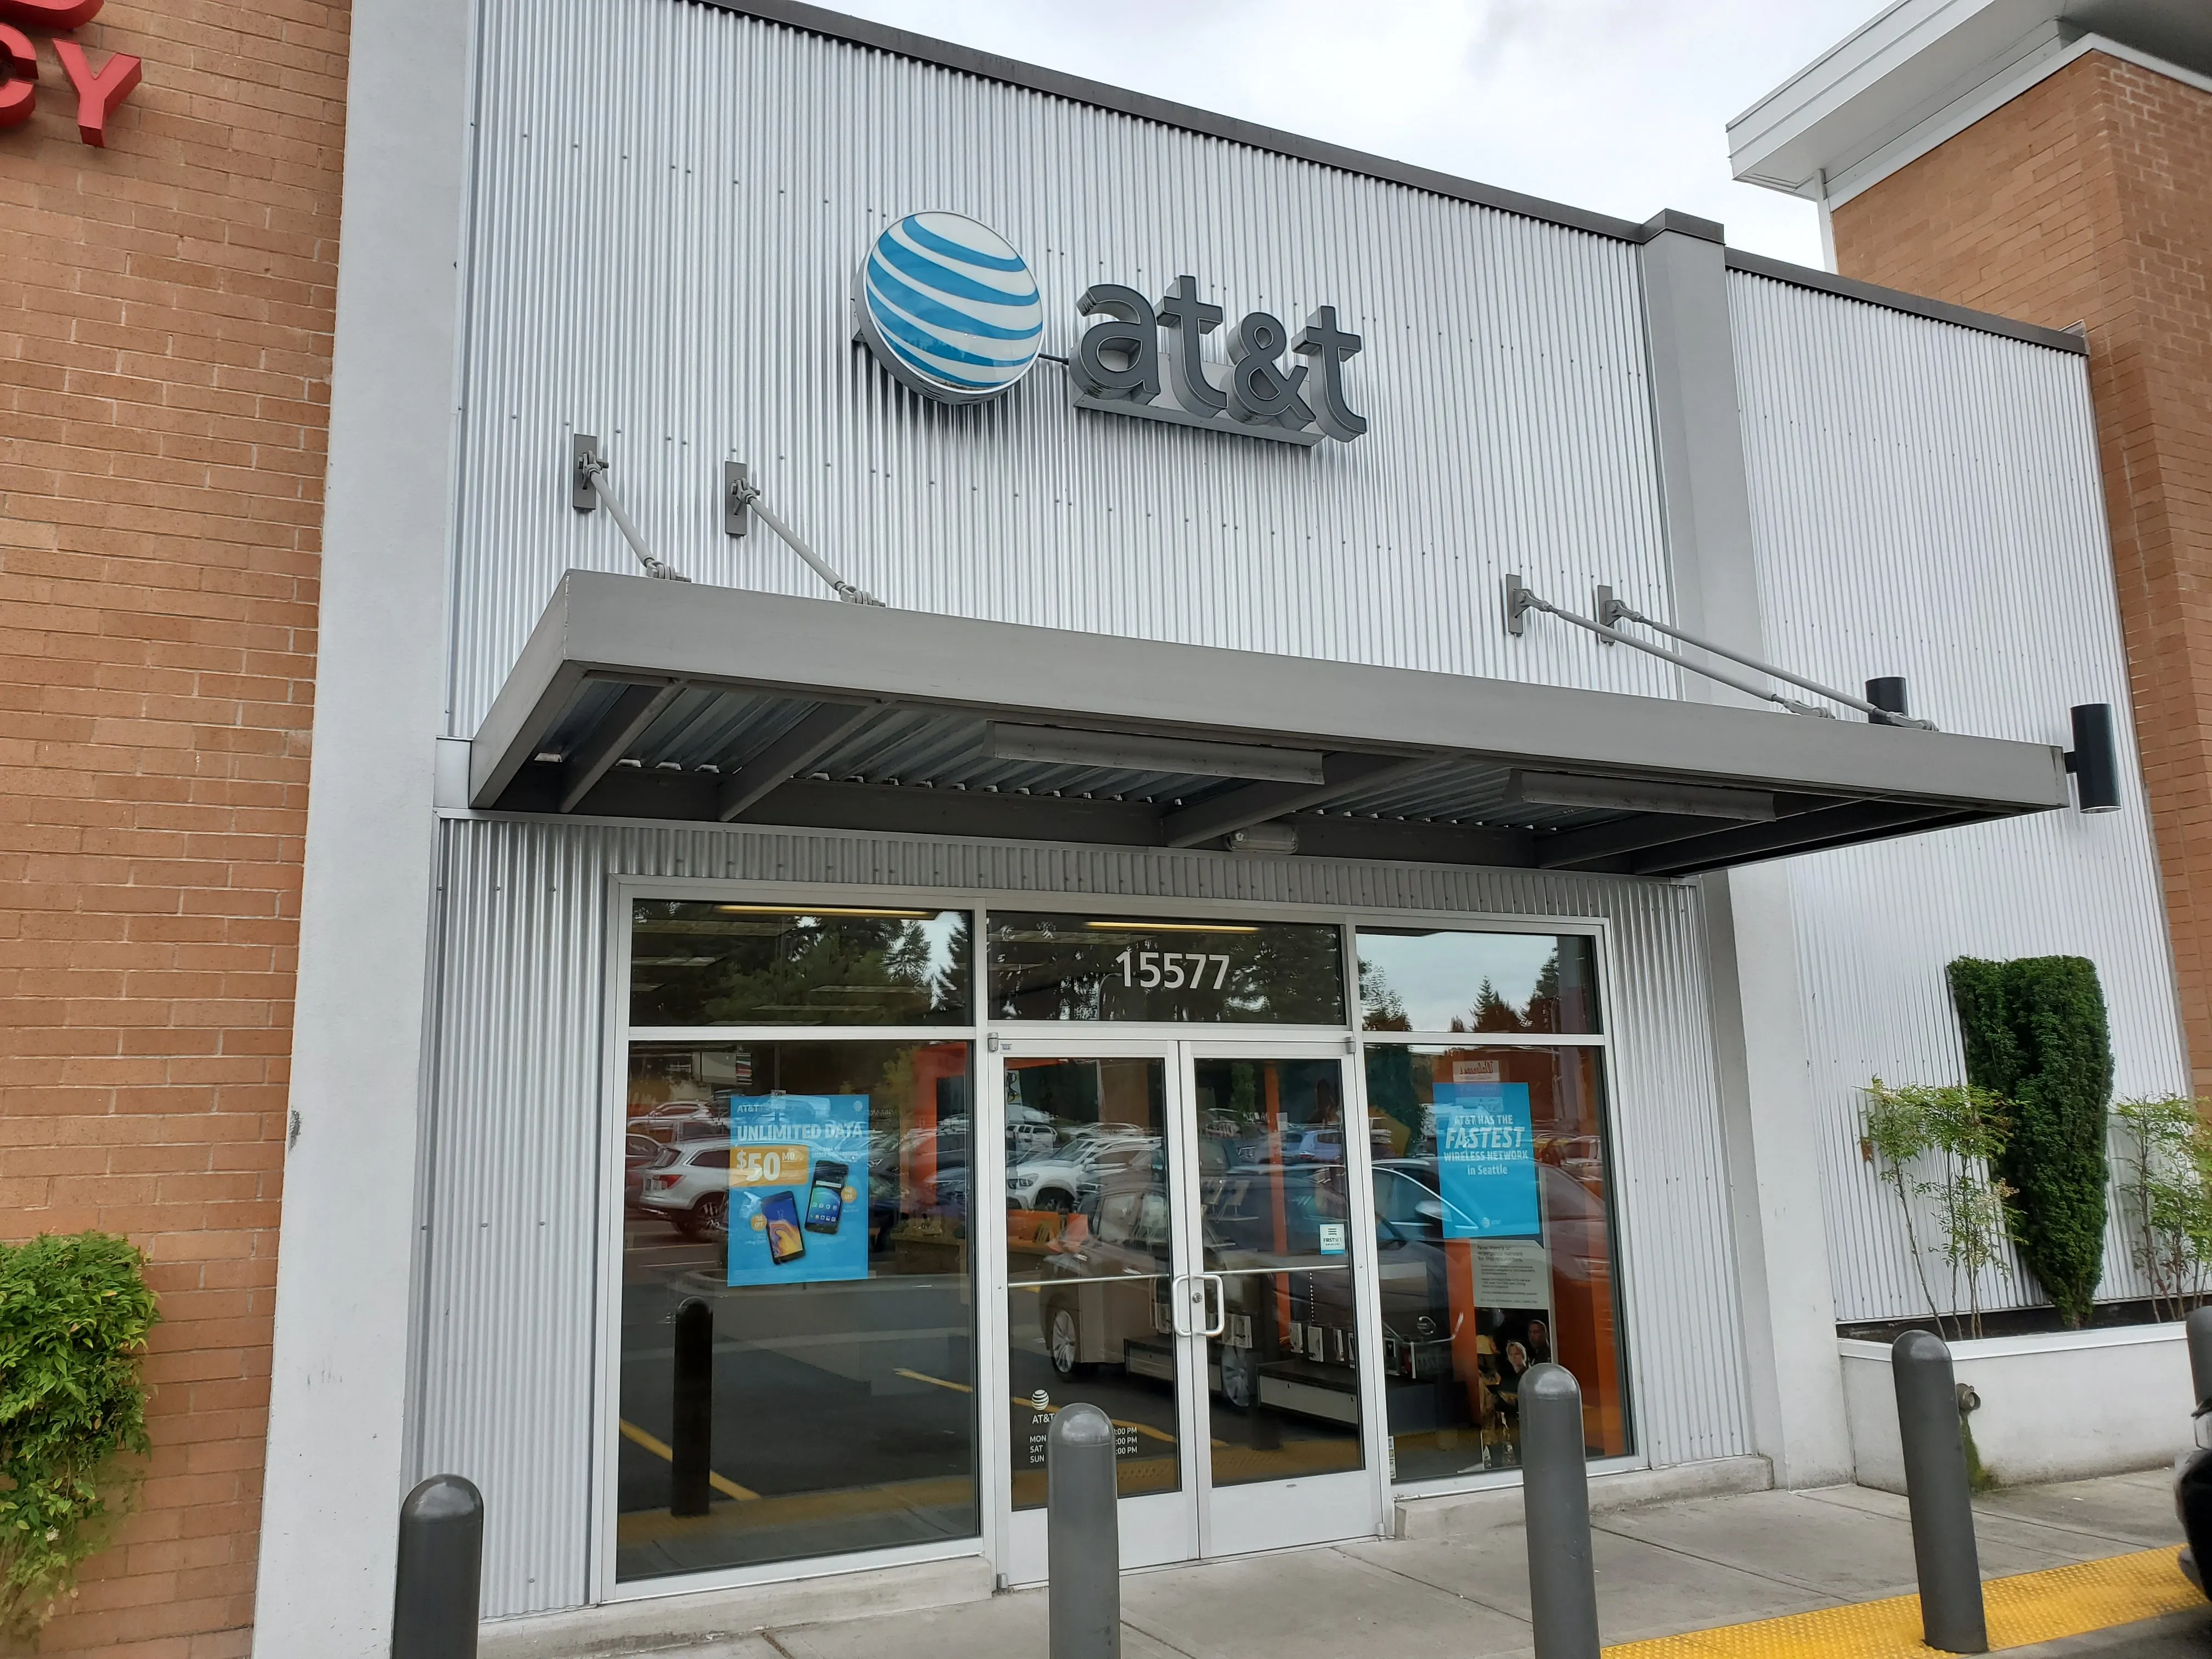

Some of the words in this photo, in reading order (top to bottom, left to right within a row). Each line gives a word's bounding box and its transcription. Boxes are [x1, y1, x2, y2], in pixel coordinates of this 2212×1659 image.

[1069, 274, 1367, 443] at&t
[1115, 950, 1230, 990] 15577
[737, 1104, 759, 1113] AT&T
[1454, 1115, 1476, 1125] AT&T
[1477, 1115, 1495, 1125] HAS
[1497, 1114, 1514, 1125] THE
[737, 1124, 822, 1142] UNLIMITED
[825, 1123, 863, 1139] DATA
[1445, 1126, 1525, 1149] FASTEST
[1444, 1151, 1485, 1162] WIRELESS
[1487, 1150, 1528, 1160] NETWORK
[736, 1149, 781, 1182] $50
[1467, 1165, 1476, 1175] in
[1477, 1164, 1508, 1175] Seattle
[1032, 1413, 1055, 1424] AT&T
[1030, 1434, 1047, 1443] MON
[1030, 1444, 1043, 1453] SAT
[1030, 1454, 1045, 1464] SUN
